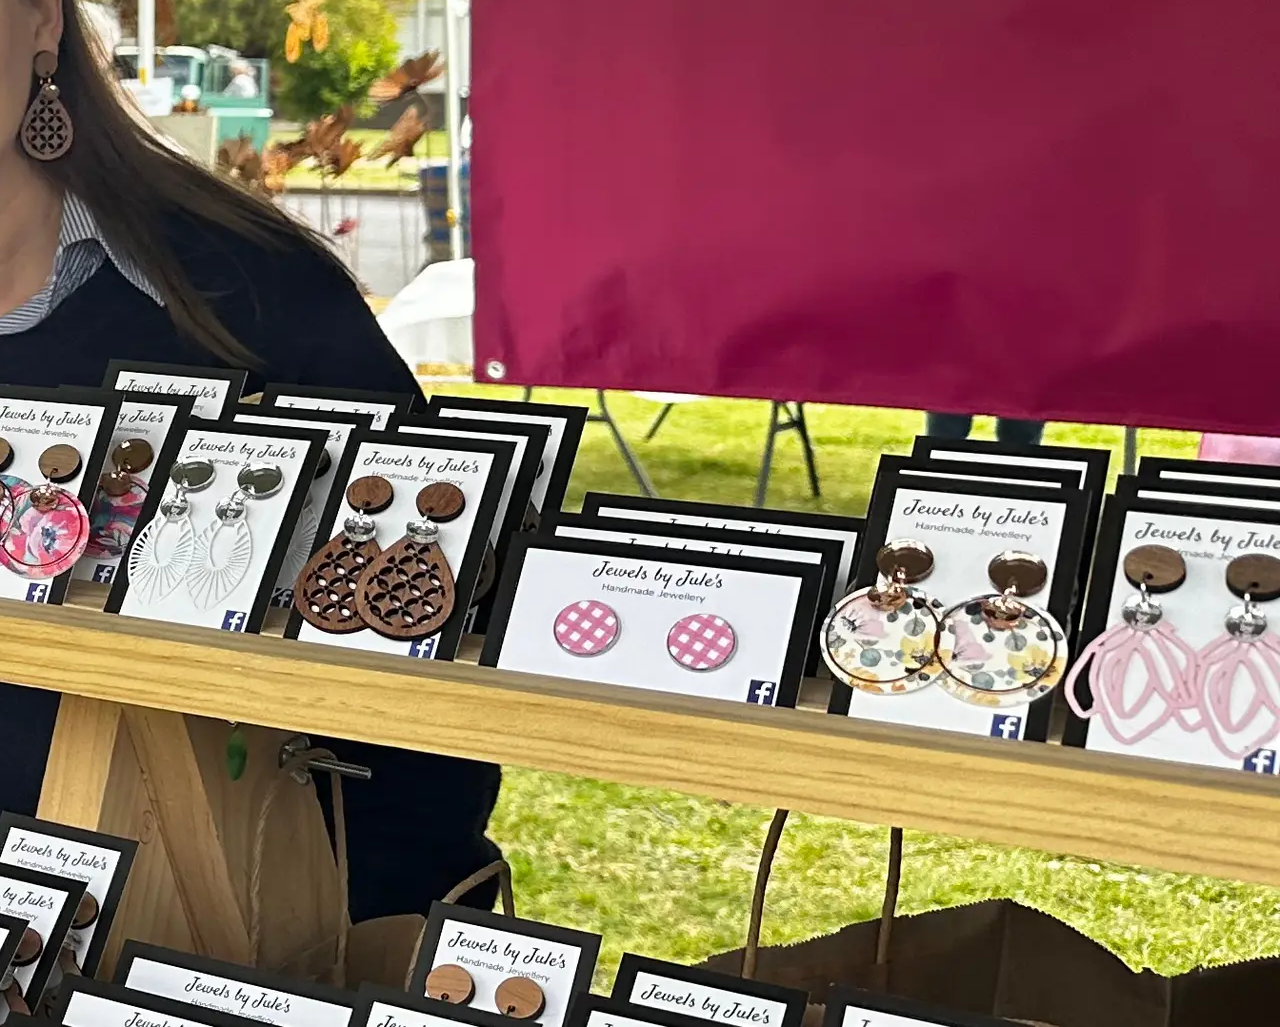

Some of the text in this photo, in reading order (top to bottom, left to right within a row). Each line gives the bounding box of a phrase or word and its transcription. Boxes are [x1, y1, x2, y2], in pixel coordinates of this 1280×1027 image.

[40, 410, 54, 427] by
[55, 411, 92, 426] Jule's
[123, 409, 165, 423] Jule's
[1, 425, 79, 439] Handmade Jewellery
[188, 437, 297, 459] Jewels by Jule's
[363, 451, 479, 475] Jewels by Jule's
[903, 498, 1049, 527] Jewels by Jule's
[915, 521, 1032, 542] Handmade Jewellery
[1135, 522, 1280, 551] Jewels by Jule
[99, 566, 113, 583] f
[592, 561, 723, 589] Jewels by Jule's
[31, 584, 47, 603] f
[601, 583, 706, 604] Handmade Jewellery
[228, 612, 242, 631] f
[416, 638, 431, 658] f
[755, 682, 773, 705] f
[998, 716, 1018, 740] f
[1251, 750, 1272, 773] f
[11, 837, 108, 871] Jewels by Jule's
[3, 887, 18, 906] by
[18, 891, 54, 910] Jule's
[448, 931, 566, 969] Jewels by Jule's
[185, 976, 230, 999] Jewels
[235, 986, 250, 1008] by
[252, 992, 291, 1014] Jule's
[641, 983, 771, 1025] Jewels by Jule's
